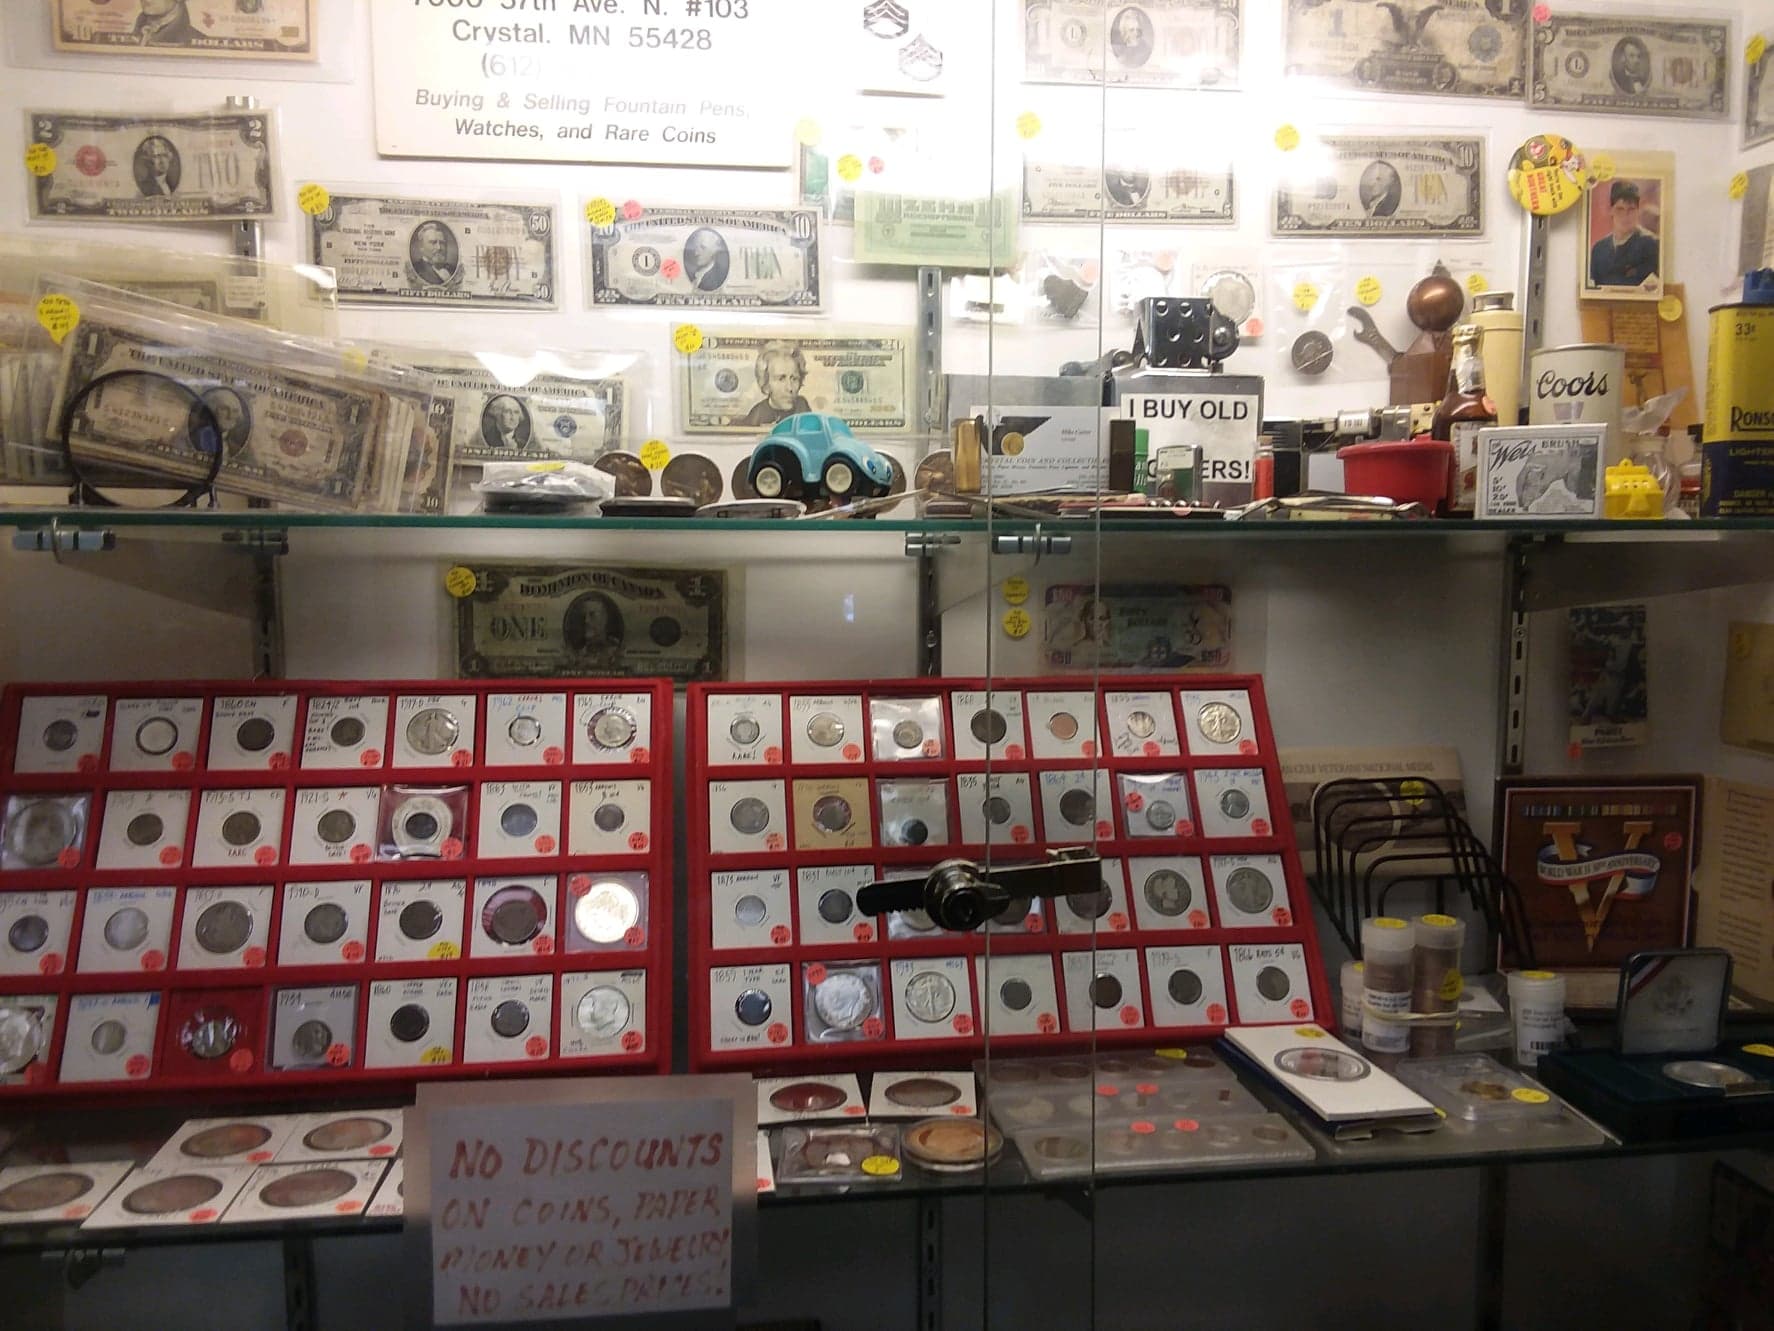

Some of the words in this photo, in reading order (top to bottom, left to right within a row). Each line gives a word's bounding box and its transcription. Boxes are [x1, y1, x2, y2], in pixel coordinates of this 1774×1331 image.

[685, 0, 748, 19] #103
[569, 24, 610, 46] MN
[628, 26, 712, 50] 55428
[416, 89, 484, 111] Buying
[496, 91, 511, 109] &
[523, 92, 591, 116] Selling
[604, 96, 687, 115] Fountain
[455, 118, 544, 141] Watches,
[557, 124, 593, 140] and
[605, 124, 650, 142] Rare
[662, 126, 717, 144] Coins
[1537, 369, 1608, 400] Coors
[1129, 398, 1134, 418] I
[1143, 399, 1193, 419] BUY
[1200, 400, 1248, 420] OLD
[490, 614, 549, 643] ONE
[449, 1140, 502, 1179] NO
[523, 1132, 723, 1176] DISCOUNTS
[441, 1199, 490, 1231] ON
[513, 1195, 622, 1231] COINS,
[634, 1186, 721, 1220] PAPER
[458, 1284, 500, 1316] NO
